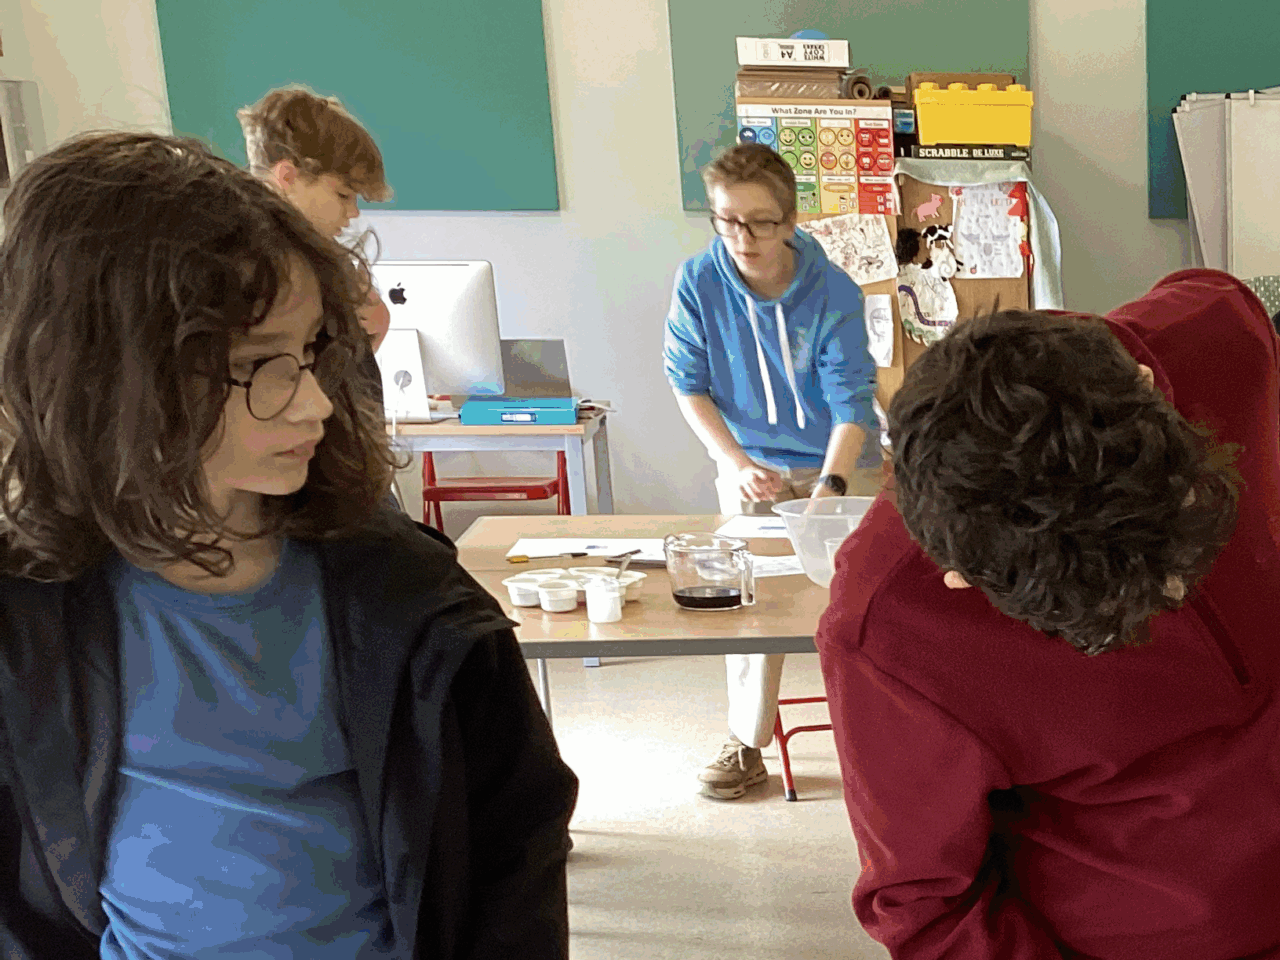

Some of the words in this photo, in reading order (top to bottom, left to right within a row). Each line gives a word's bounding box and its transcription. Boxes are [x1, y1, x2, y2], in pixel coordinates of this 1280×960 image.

[781, 50, 793, 58] A4
[830, 108, 843, 116] You
[920, 148, 968, 158] SCRABBLE
[972, 149, 984, 157] DE
[985, 149, 1004, 158] LUXE
